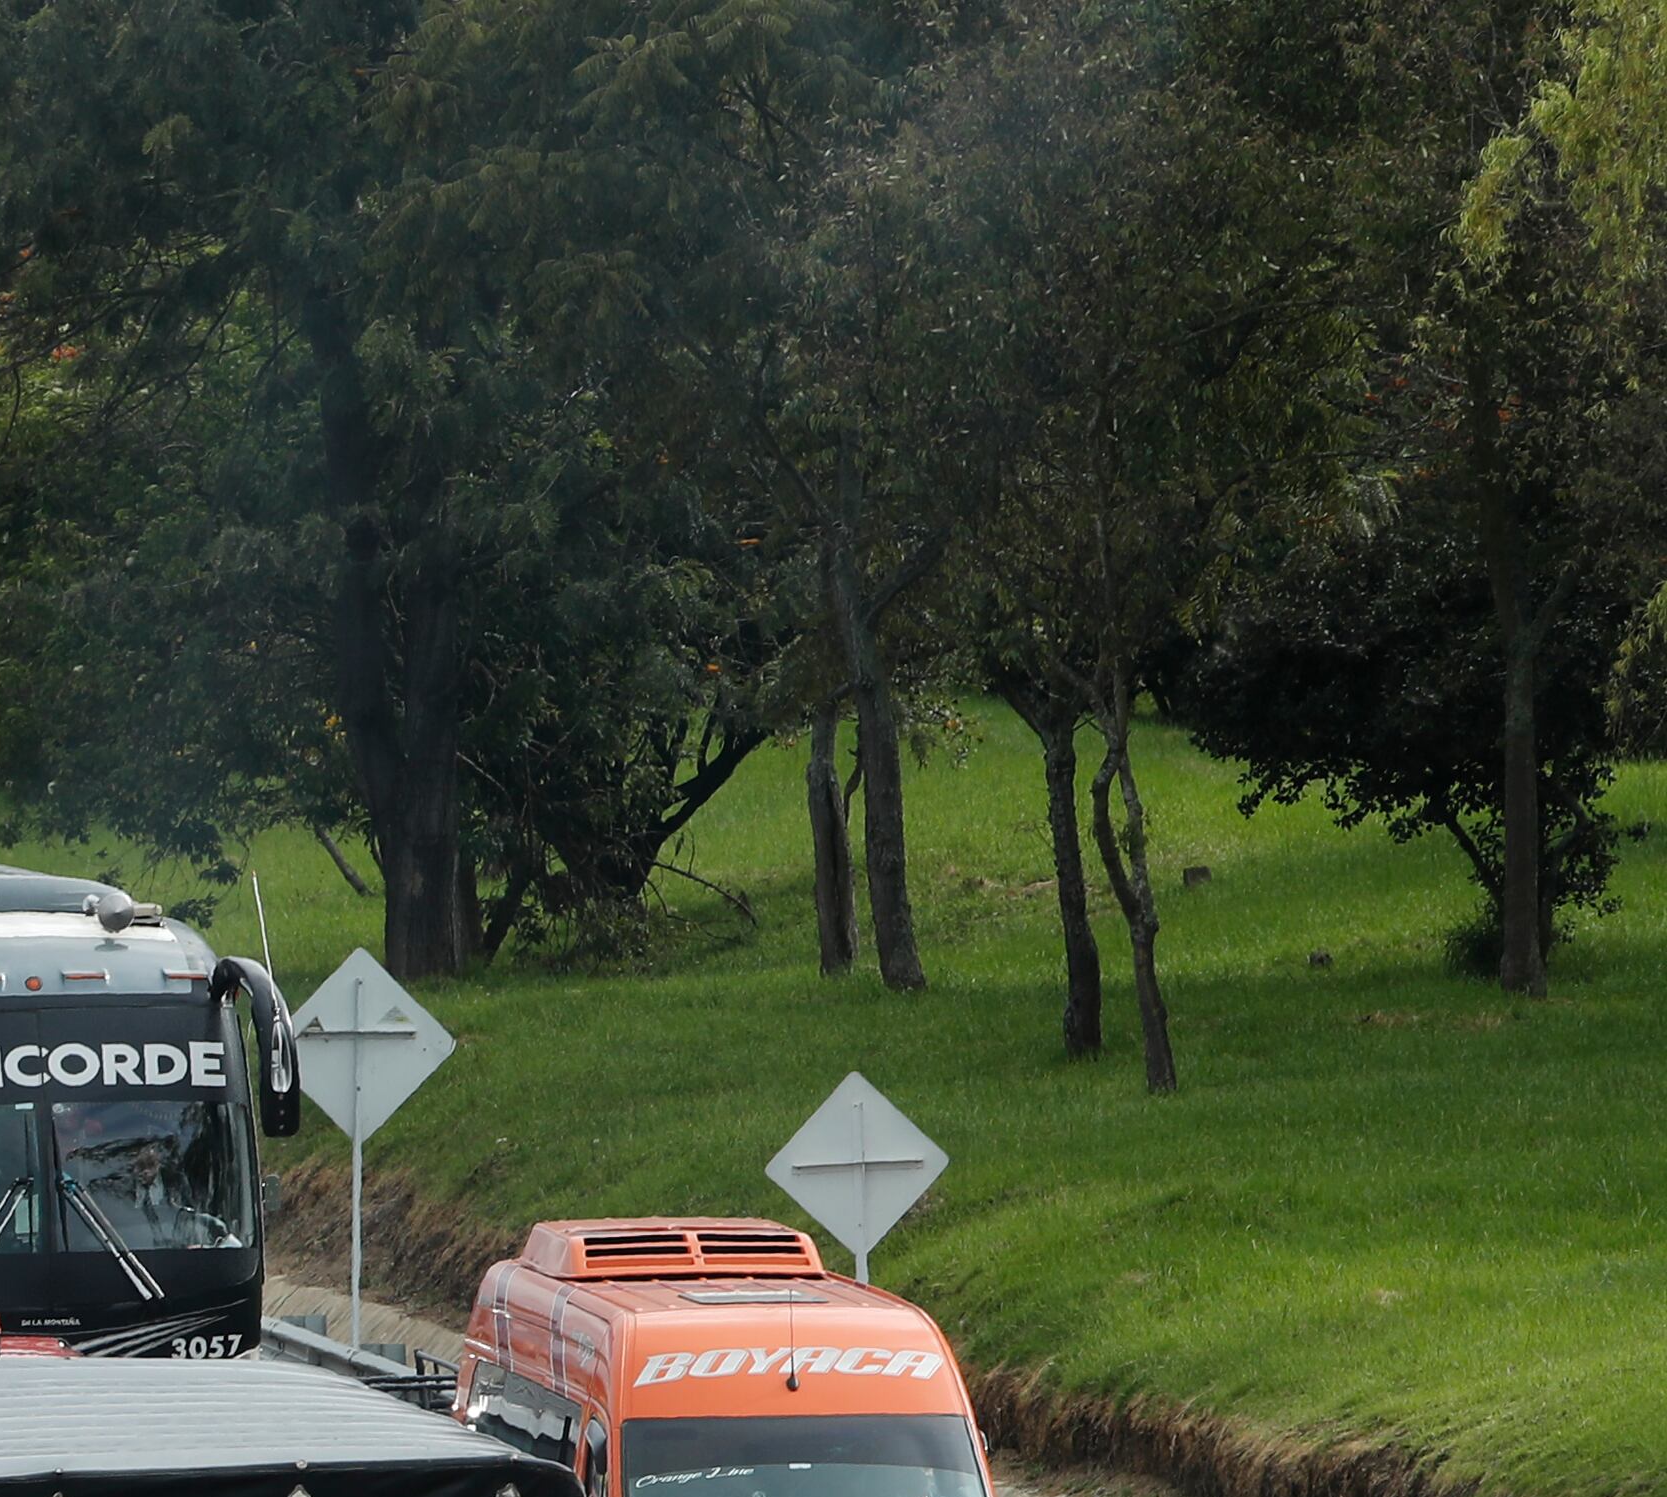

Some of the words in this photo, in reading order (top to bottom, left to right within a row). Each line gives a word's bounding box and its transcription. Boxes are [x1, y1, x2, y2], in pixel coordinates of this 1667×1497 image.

[170, 1333, 244, 1360] 3057
[633, 1346, 944, 1387] BOYACA
[635, 1471, 703, 1488] Orange
